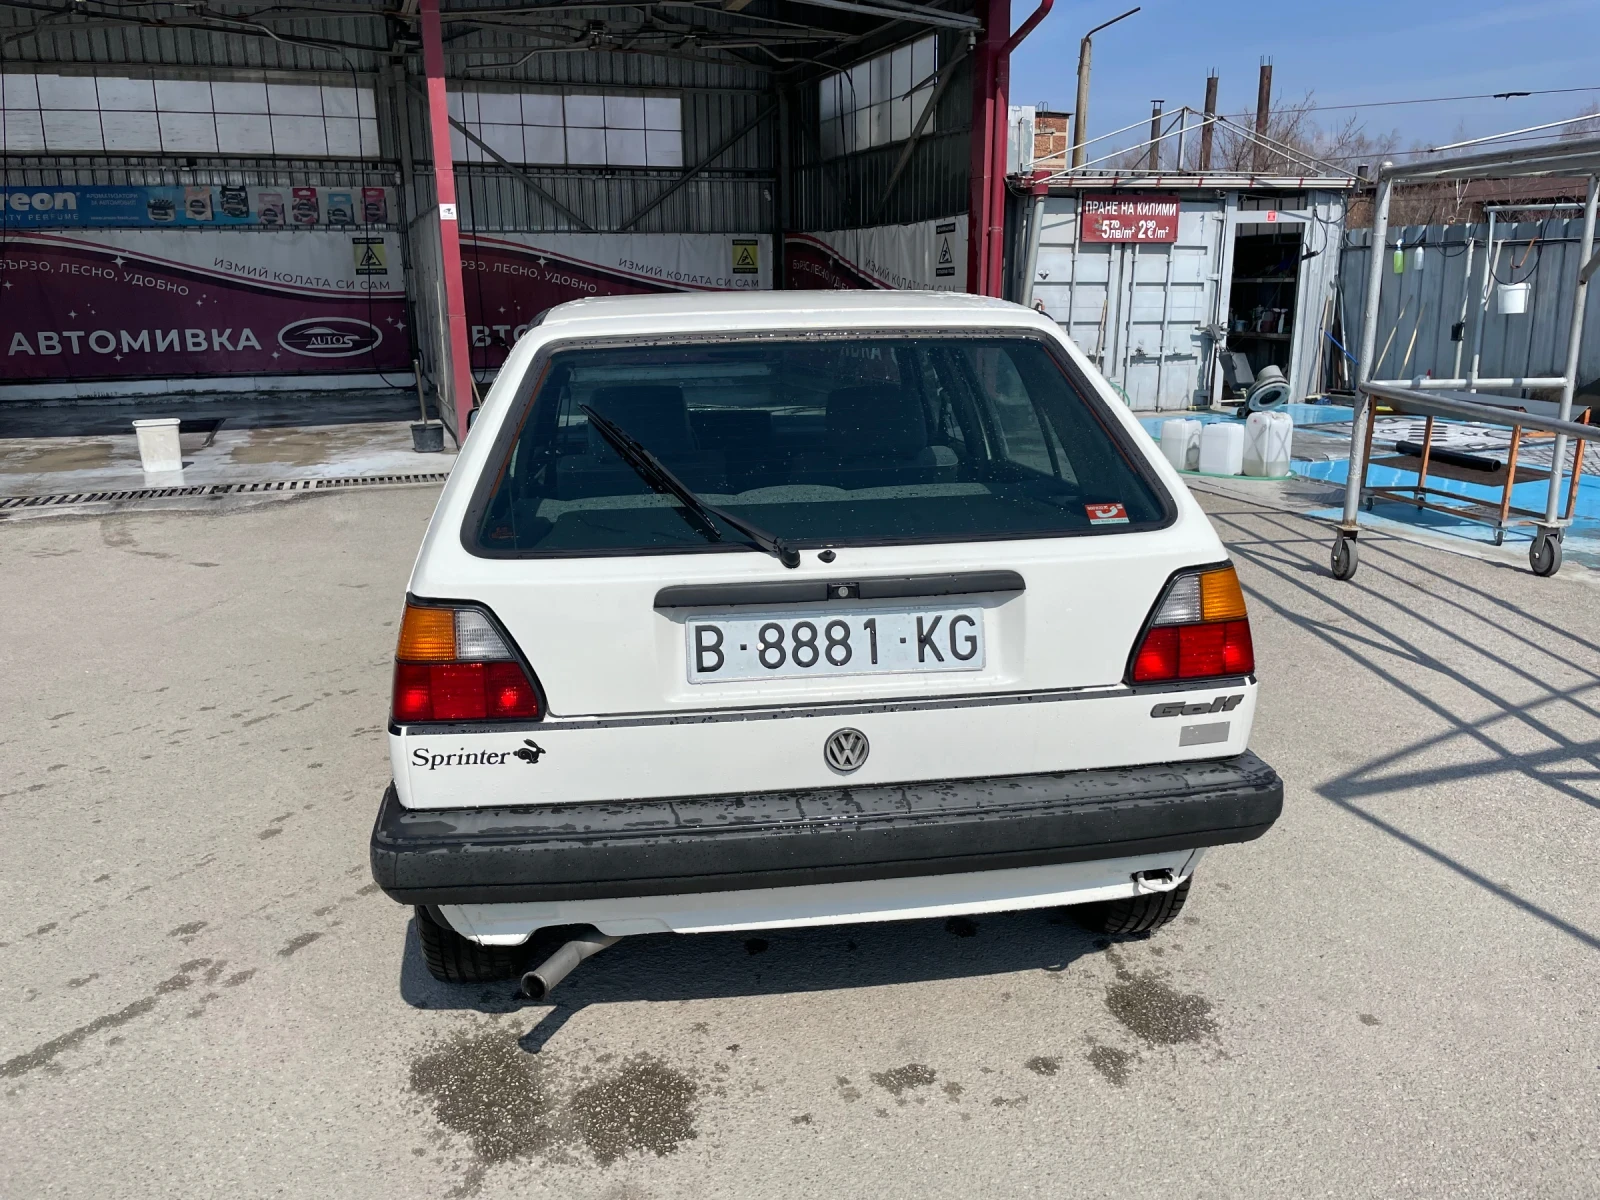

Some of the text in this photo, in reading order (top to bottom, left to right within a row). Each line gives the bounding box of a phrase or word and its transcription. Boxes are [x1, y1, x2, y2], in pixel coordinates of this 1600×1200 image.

[28, 213, 79, 221] PERFUME
[1085, 200, 1176, 216] ПРАНЕ НА КИЛИМИ
[59, 263, 118, 282] ЛЕСНО,
[123, 271, 189, 296] УДОБНО
[214, 257, 390, 290] ИЗМИЙ КОЛАТА СИ САМ
[492, 262, 541, 280] ЛЕСНО,
[544, 271, 597, 293] УДОБНО
[618, 258, 759, 288] ИЗМИЙ КОЛАТА СИ САМ
[865, 257, 890, 281] ИЗМИЙ
[8, 327, 263, 357] АВТОМИВКА
[1150, 694, 1245, 718] Golf
[411, 747, 511, 770] Sprinter
